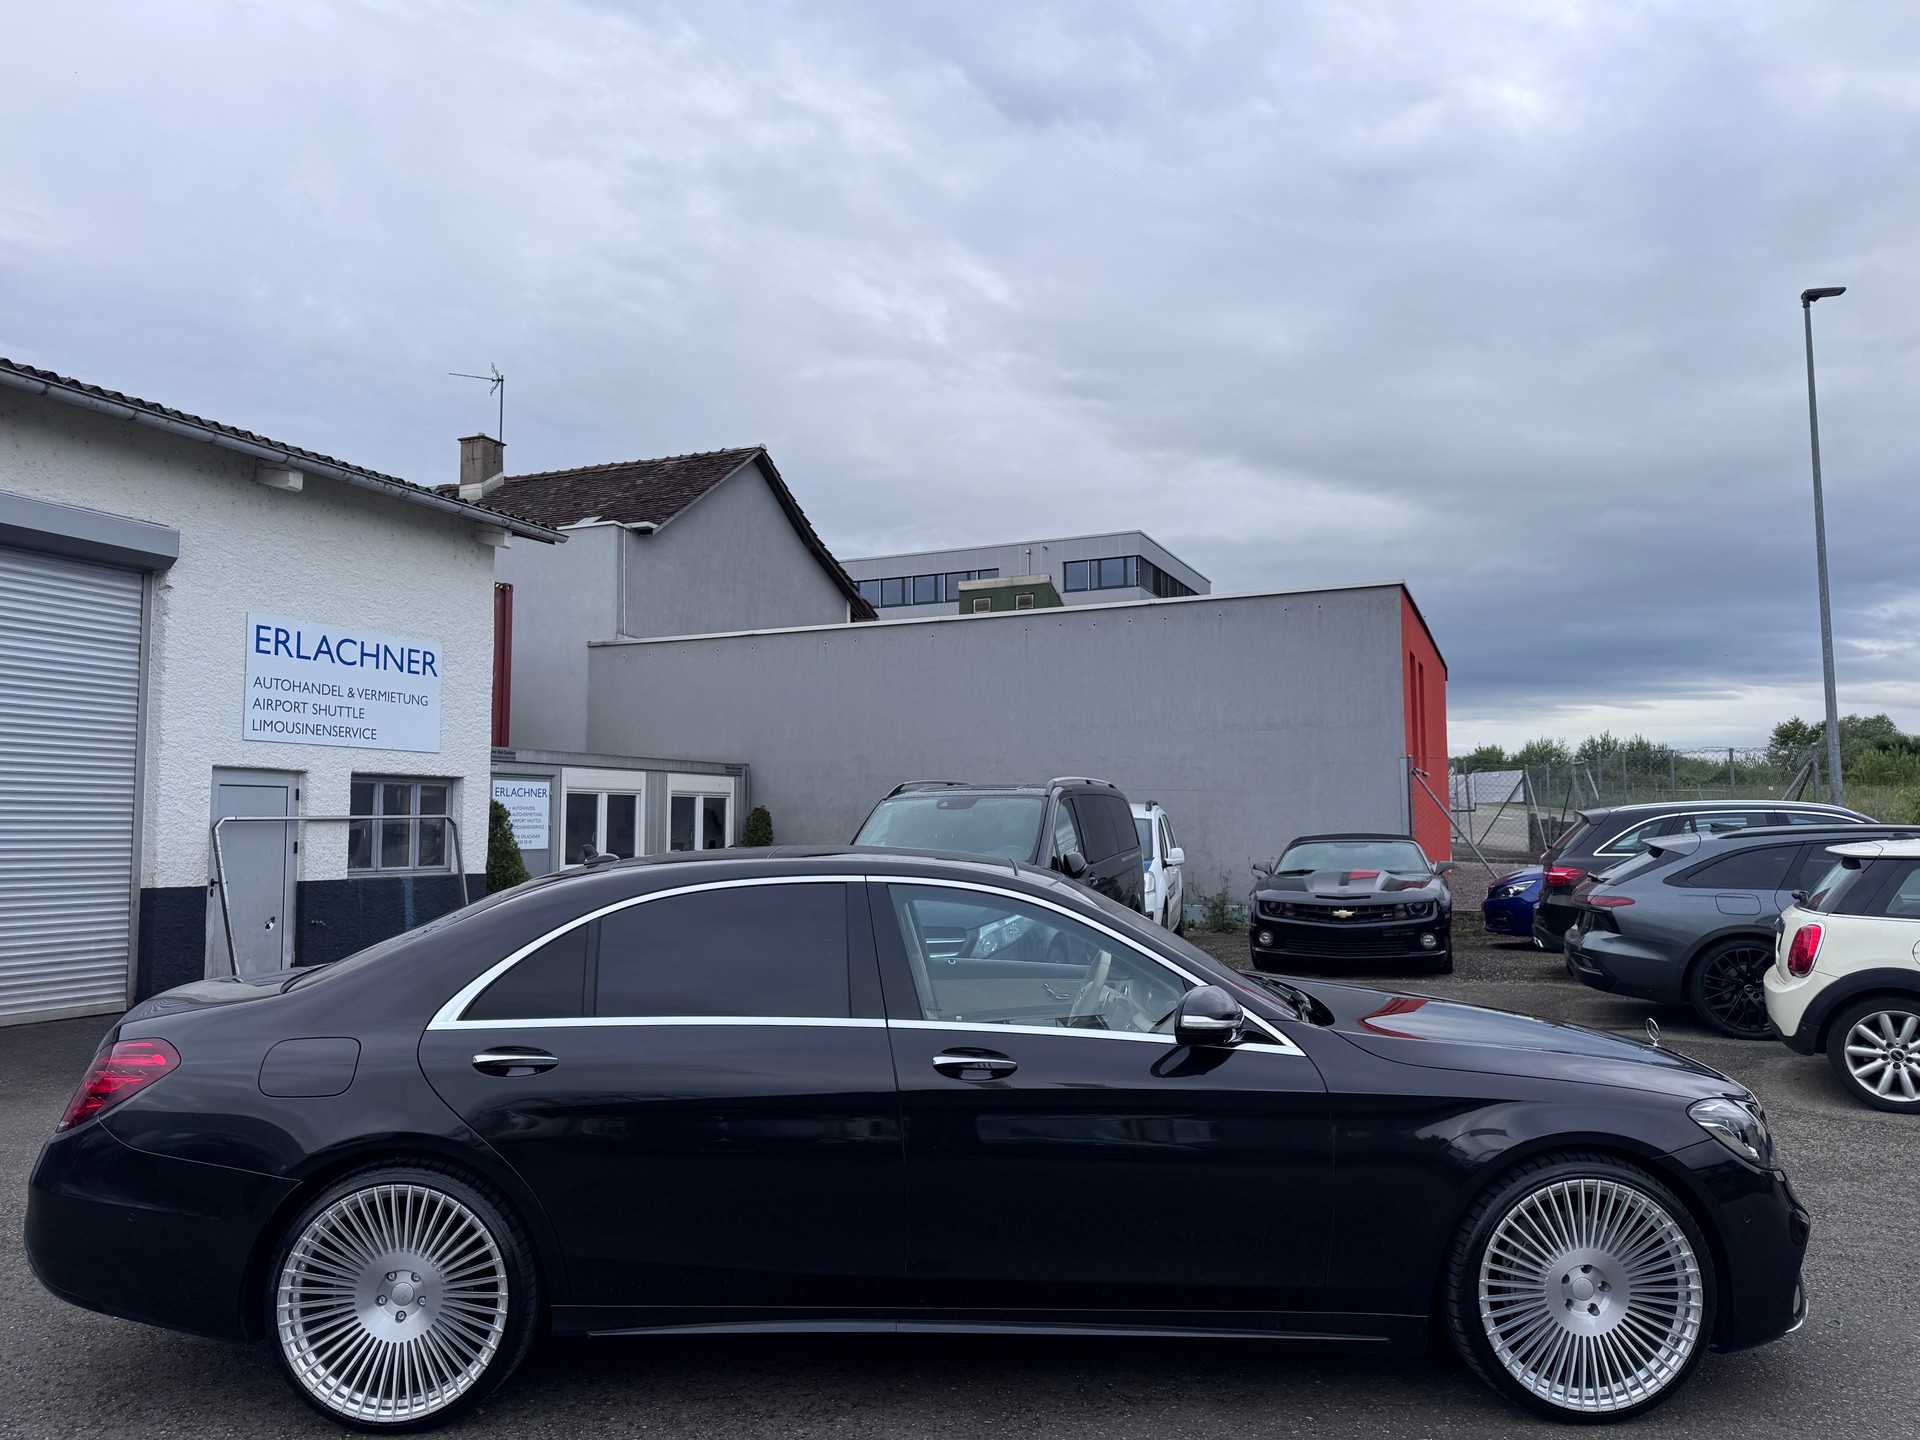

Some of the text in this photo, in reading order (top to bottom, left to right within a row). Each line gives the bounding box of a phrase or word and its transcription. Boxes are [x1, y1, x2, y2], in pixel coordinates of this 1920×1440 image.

[255, 624, 438, 677] ERLACHNER
[253, 676, 429, 706] AUTOHANDEL & VERMIETUNG
[252, 697, 365, 719] AIRPORT SHUTTLE
[252, 719, 377, 740] LIMOUSINENSERVICE
[494, 786, 548, 798] ERLACHNER
